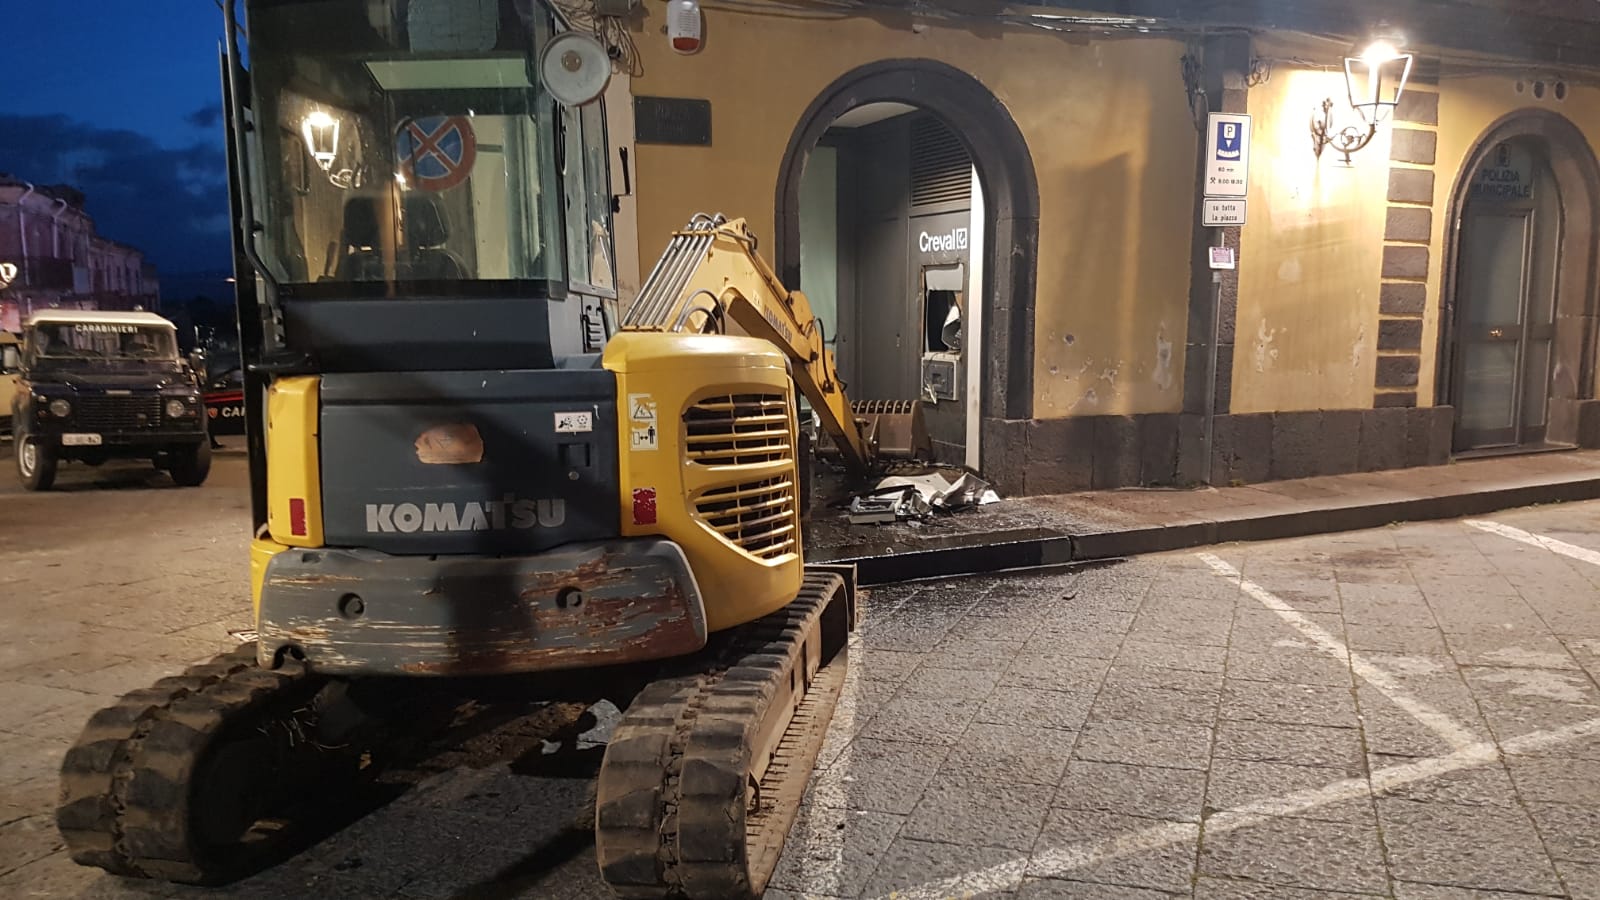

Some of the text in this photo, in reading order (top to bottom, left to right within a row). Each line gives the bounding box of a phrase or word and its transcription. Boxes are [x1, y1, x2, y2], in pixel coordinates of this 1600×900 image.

[1227, 125, 1233, 137] P
[1481, 167, 1521, 182] POLIZIA
[1222, 204, 1236, 212] tutta
[1212, 213, 1238, 222] la piazza
[919, 228, 956, 252] Creval
[75, 324, 139, 334] CARABINIERI
[365, 493, 566, 533] KOMATSU
